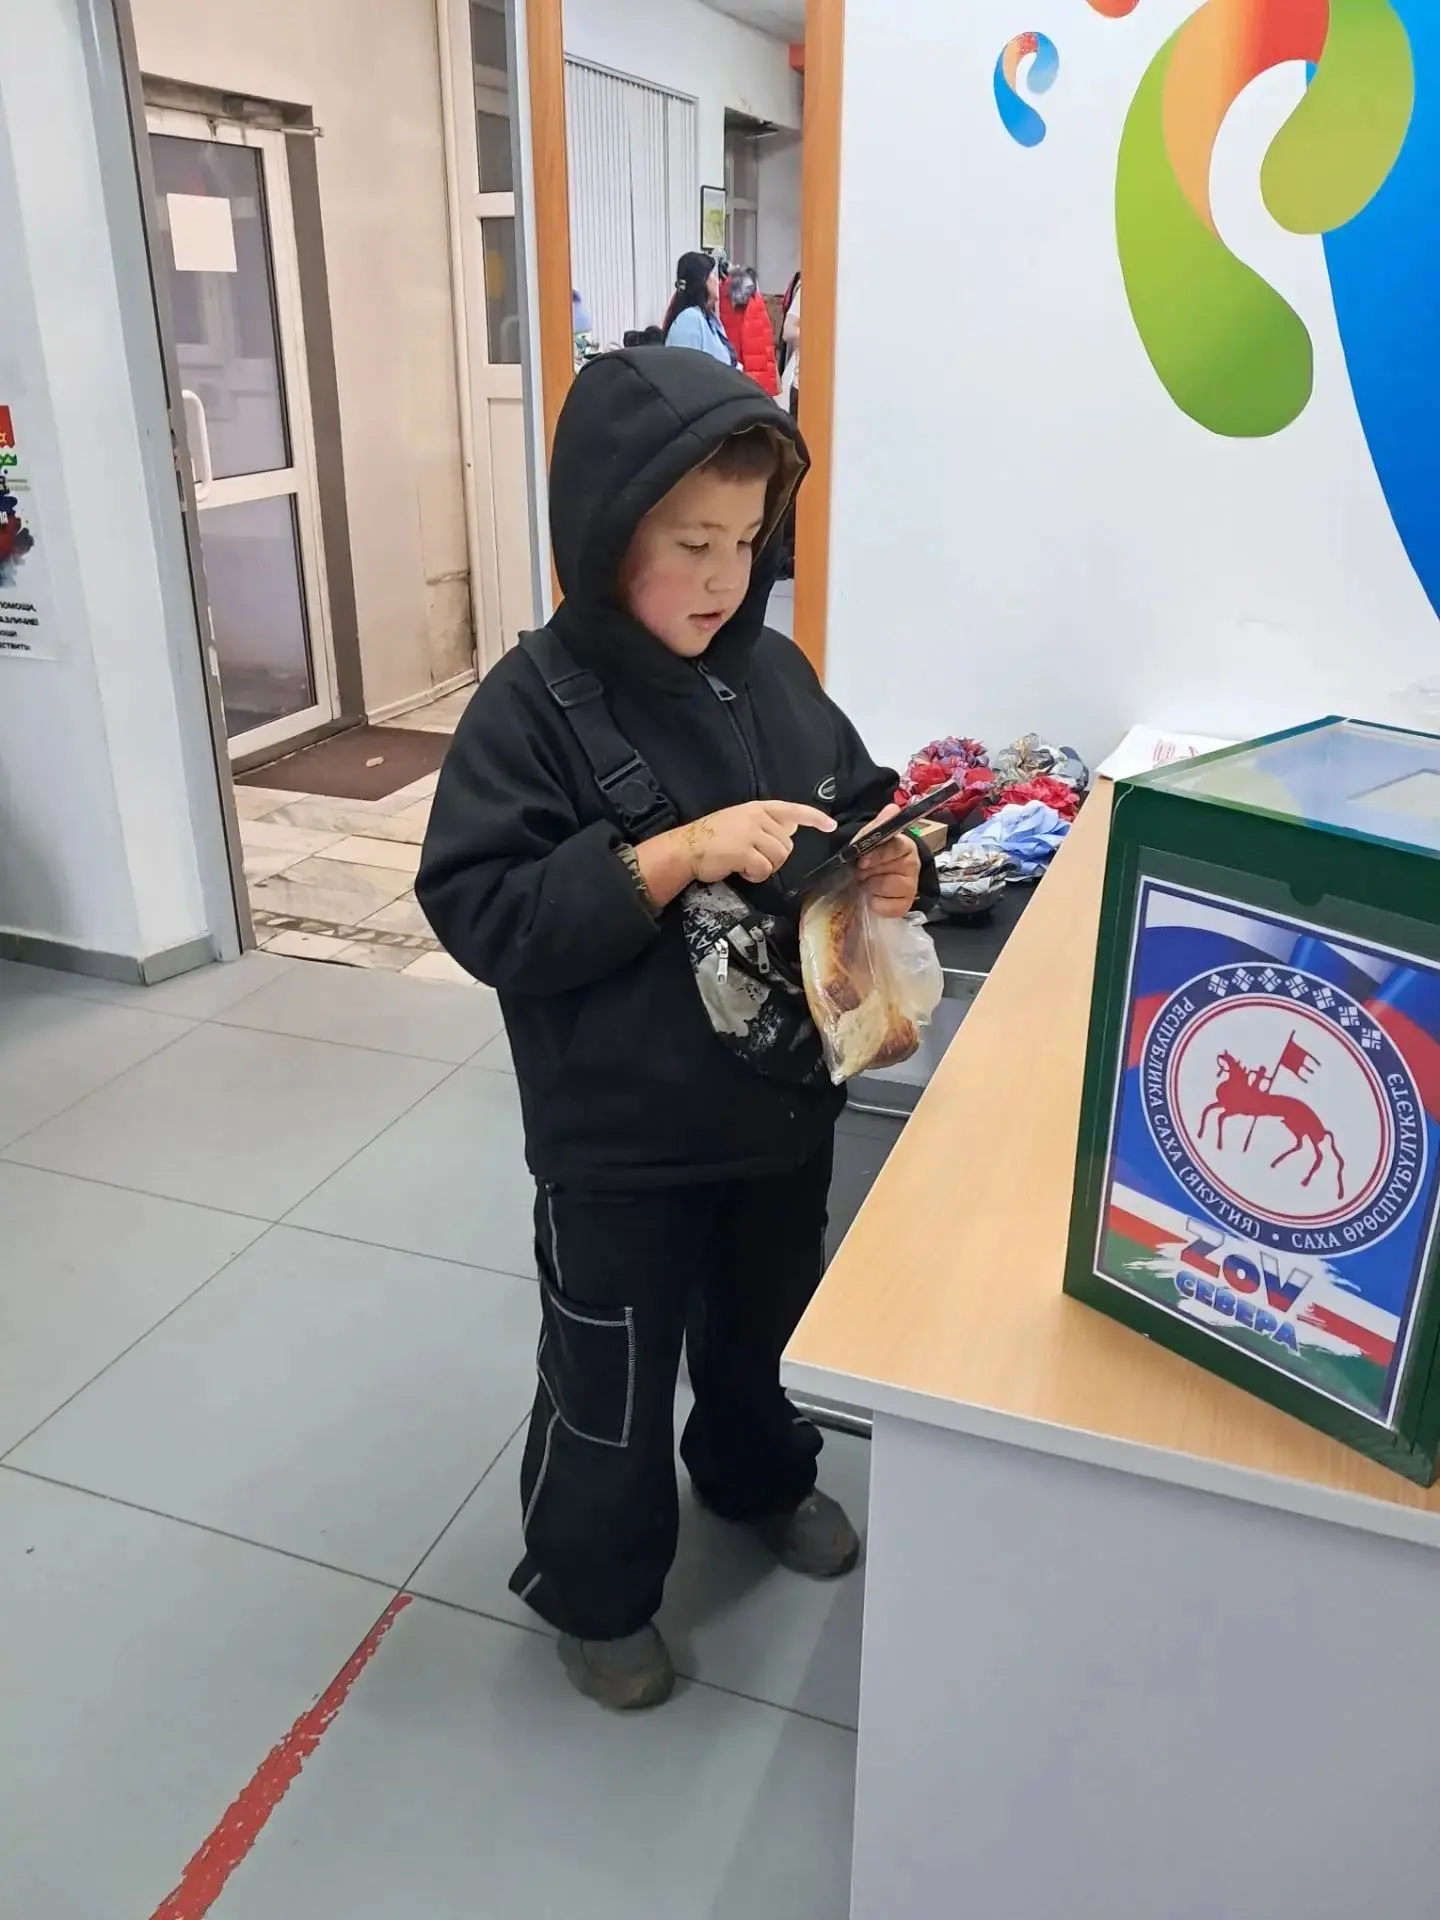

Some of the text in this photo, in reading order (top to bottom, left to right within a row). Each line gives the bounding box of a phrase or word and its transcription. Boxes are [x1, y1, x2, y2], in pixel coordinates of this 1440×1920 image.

[1149, 996, 1261, 1239] РЕСПУБЛИКА САХА (ЯКУТИЯ)
[1291, 1232, 1341, 1250] САХА
[1174, 1270, 1301, 1356] СЕВЕРА
